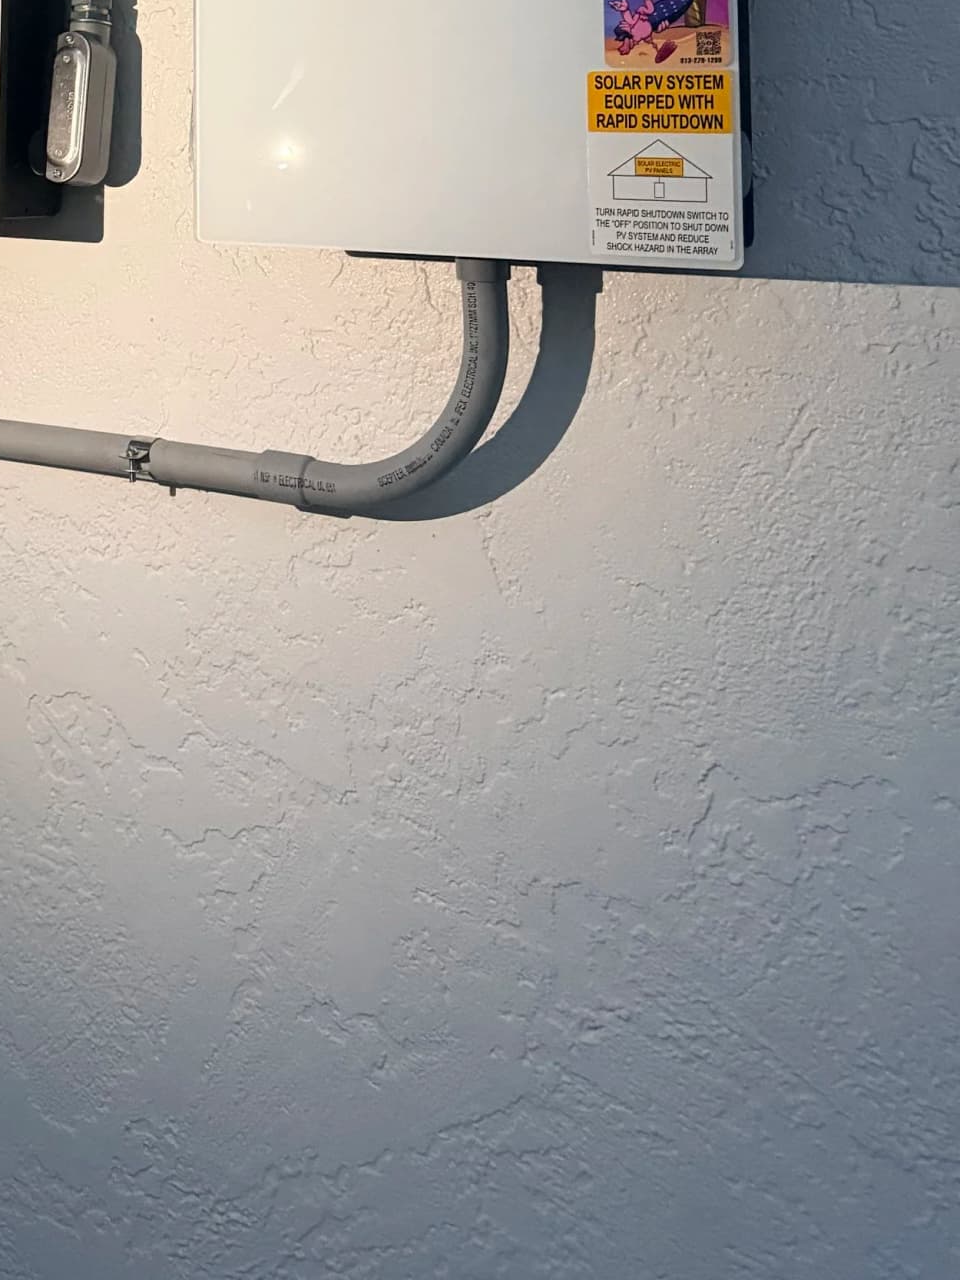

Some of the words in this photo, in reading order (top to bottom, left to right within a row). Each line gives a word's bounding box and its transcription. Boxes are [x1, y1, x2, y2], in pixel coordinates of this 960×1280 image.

[594, 75, 641, 90] SOLAR
[645, 76, 663, 90] PV
[666, 75, 724, 90] SYSTEM
[605, 94, 674, 110] EQUIPPED
[678, 95, 714, 109] WITH
[596, 114, 638, 128] RAPID
[642, 114, 724, 129] SHUTDOWN
[596, 208, 615, 216] TURN
[617, 208, 640, 218] RAPID
[641, 209, 685, 219] SHUTDOWN
[687, 211, 716, 220] SWITCH
[718, 212, 729, 220] TO
[596, 219, 610, 228] THE
[633, 220, 669, 230] POSITION
[670, 222, 681, 230] TO
[682, 223, 704, 232] SHUT
[705, 224, 729, 232] DOWN
[616, 231, 628, 240] PV
[628, 232, 659, 241] SYSTEM
[660, 233, 676, 242] AND
[678, 234, 709, 244] REDUCE
[606, 242, 632, 251] SHOCK
[634, 244, 665, 253] HAZARD
[677, 246, 692, 254] THE
[692, 246, 718, 255] ARRAY
[462, 355, 478, 398] ELECTRICAL
[278, 474, 316, 490] ELECTRICAL
